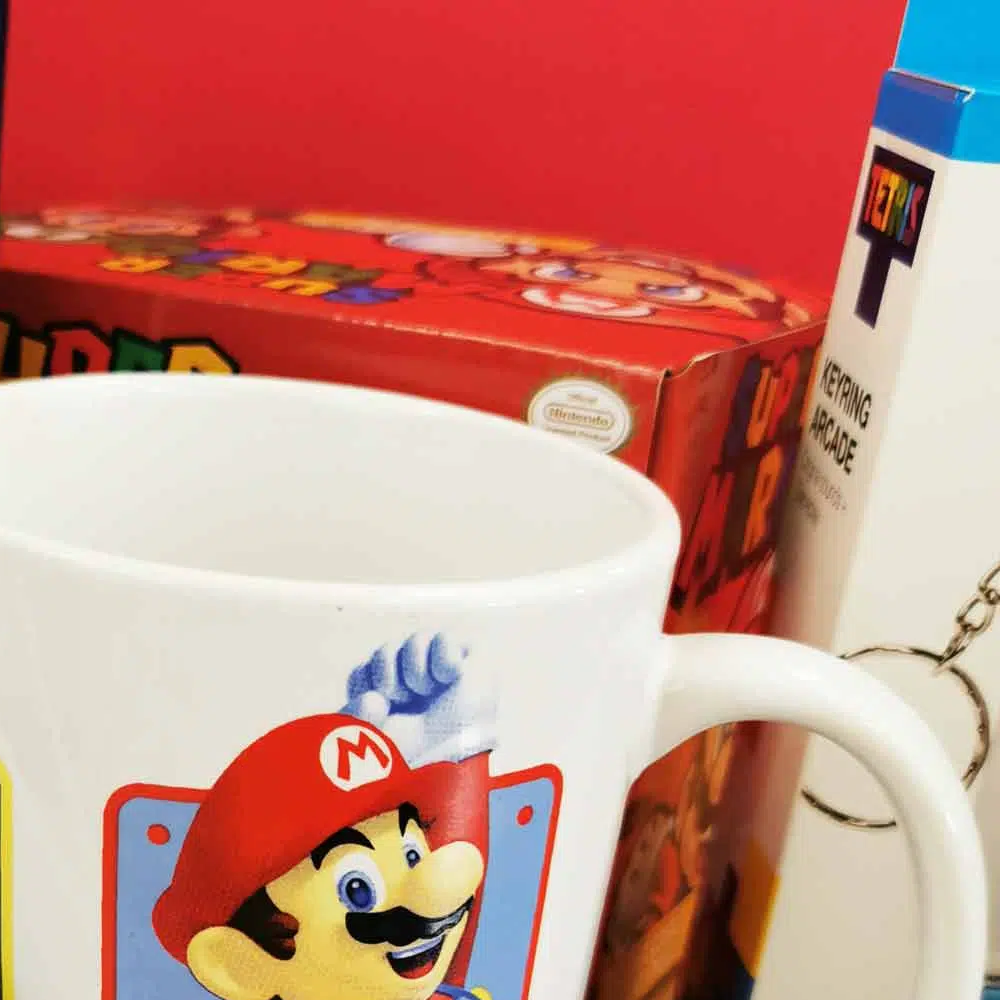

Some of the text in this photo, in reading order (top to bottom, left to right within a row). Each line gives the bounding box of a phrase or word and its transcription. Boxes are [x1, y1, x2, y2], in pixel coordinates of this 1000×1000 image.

[863, 165, 924, 247] TETRIS
[820, 357, 872, 431] KEYRING
[809, 403, 857, 475] ARCADE
